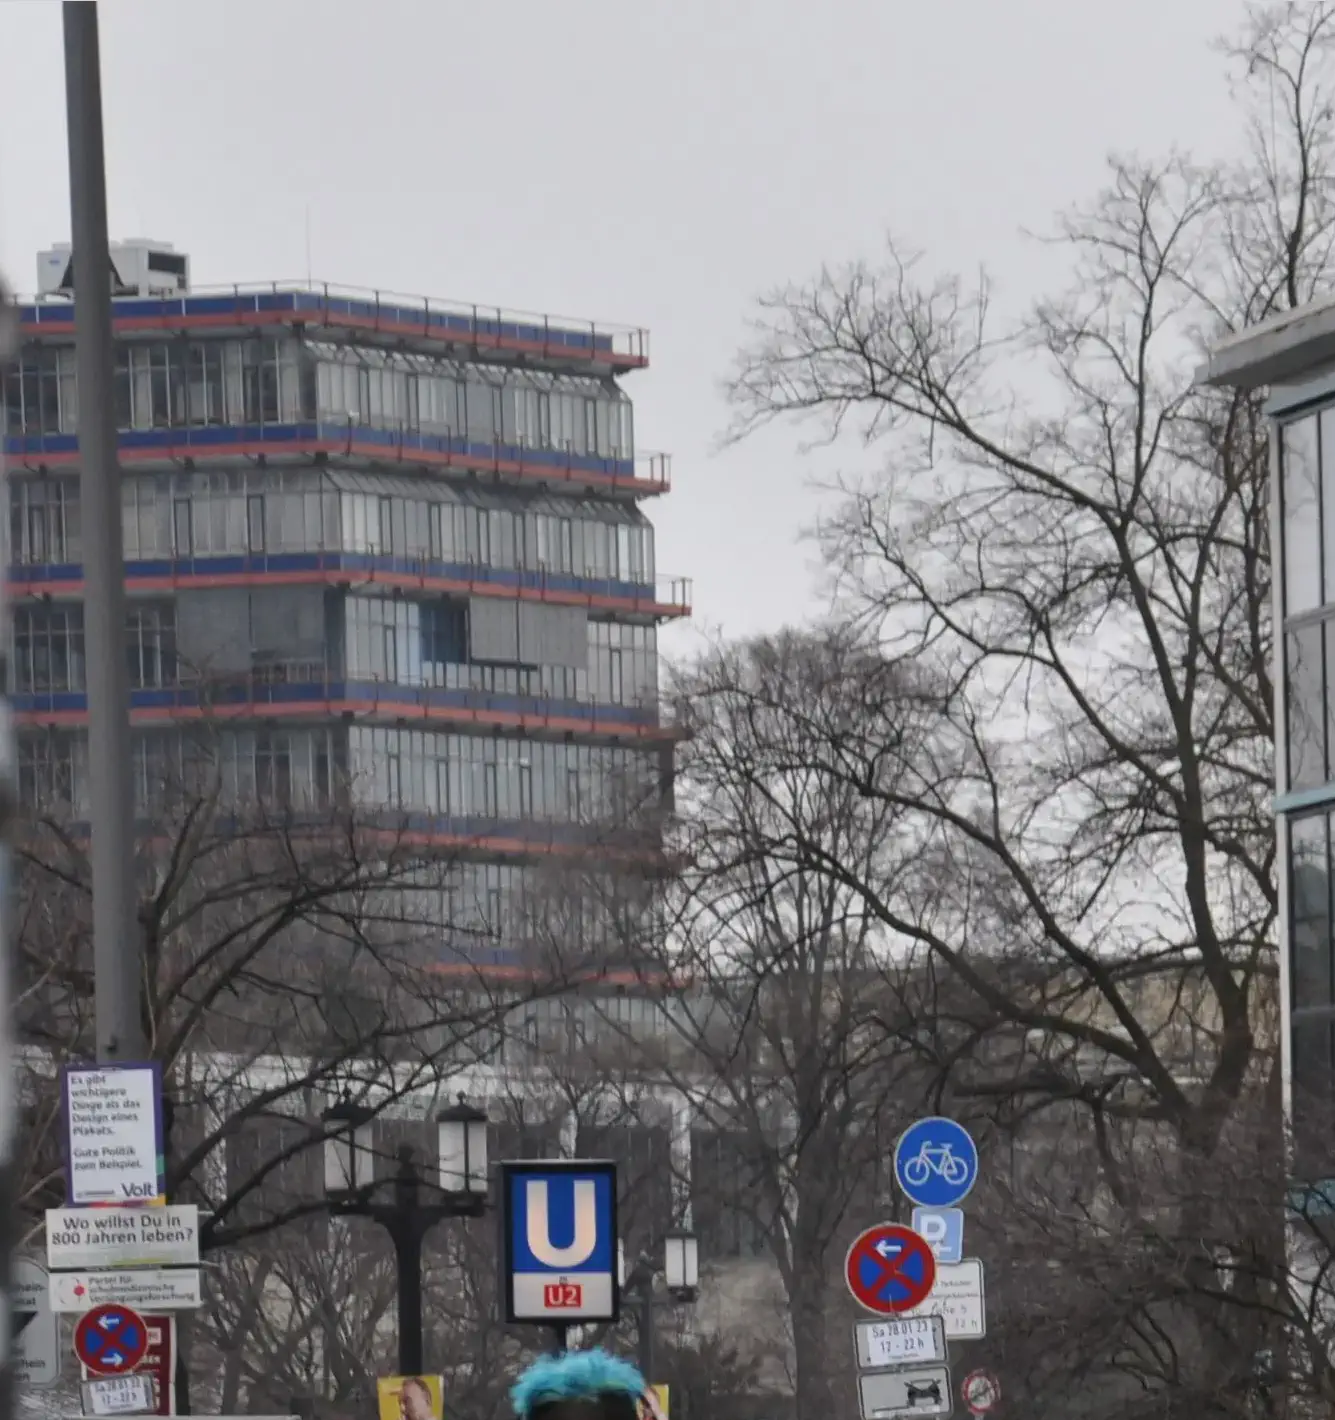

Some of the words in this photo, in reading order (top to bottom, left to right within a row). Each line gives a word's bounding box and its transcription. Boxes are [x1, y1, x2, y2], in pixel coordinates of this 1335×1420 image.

[121, 1182, 153, 1197] Volt
[63, 1218, 89, 1230] Wo
[94, 1215, 135, 1228] willst
[140, 1214, 162, 1227] Du
[167, 1213, 181, 1226] in
[526, 1180, 597, 1268] U
[920, 1215, 947, 1241] P
[52, 1232, 81, 1245] 800
[85, 1230, 137, 1244] Jahren
[141, 1228, 194, 1242] leben?
[549, 1287, 577, 1305] U2
